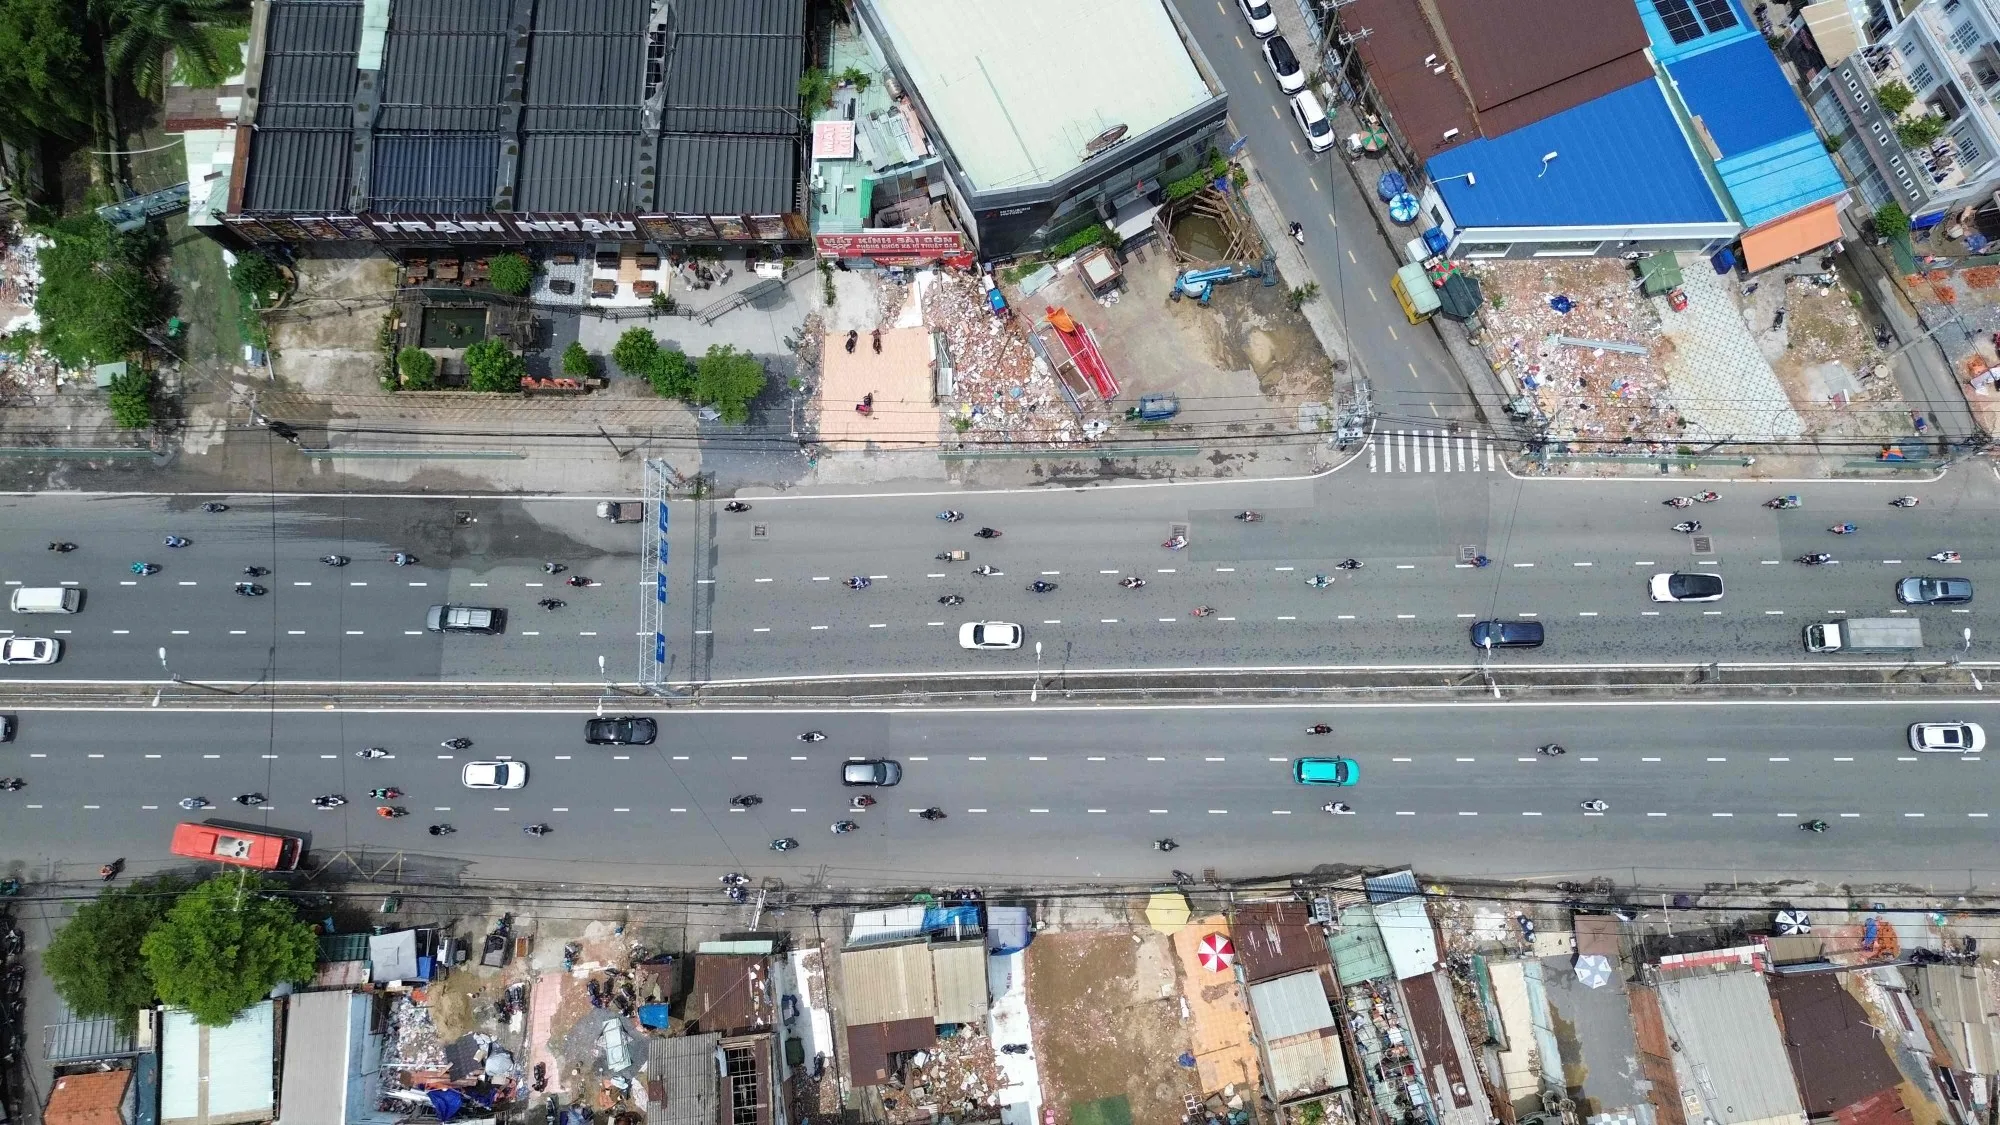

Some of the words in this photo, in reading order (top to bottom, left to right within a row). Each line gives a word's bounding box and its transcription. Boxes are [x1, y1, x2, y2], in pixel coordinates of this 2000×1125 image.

[372, 221, 505, 233] TRẠM
[515, 218, 637, 233] NHẬU
[858, 236, 892, 244] KÍNH
[896, 236, 920, 244] SÀI
[923, 236, 953, 244] GÒN
